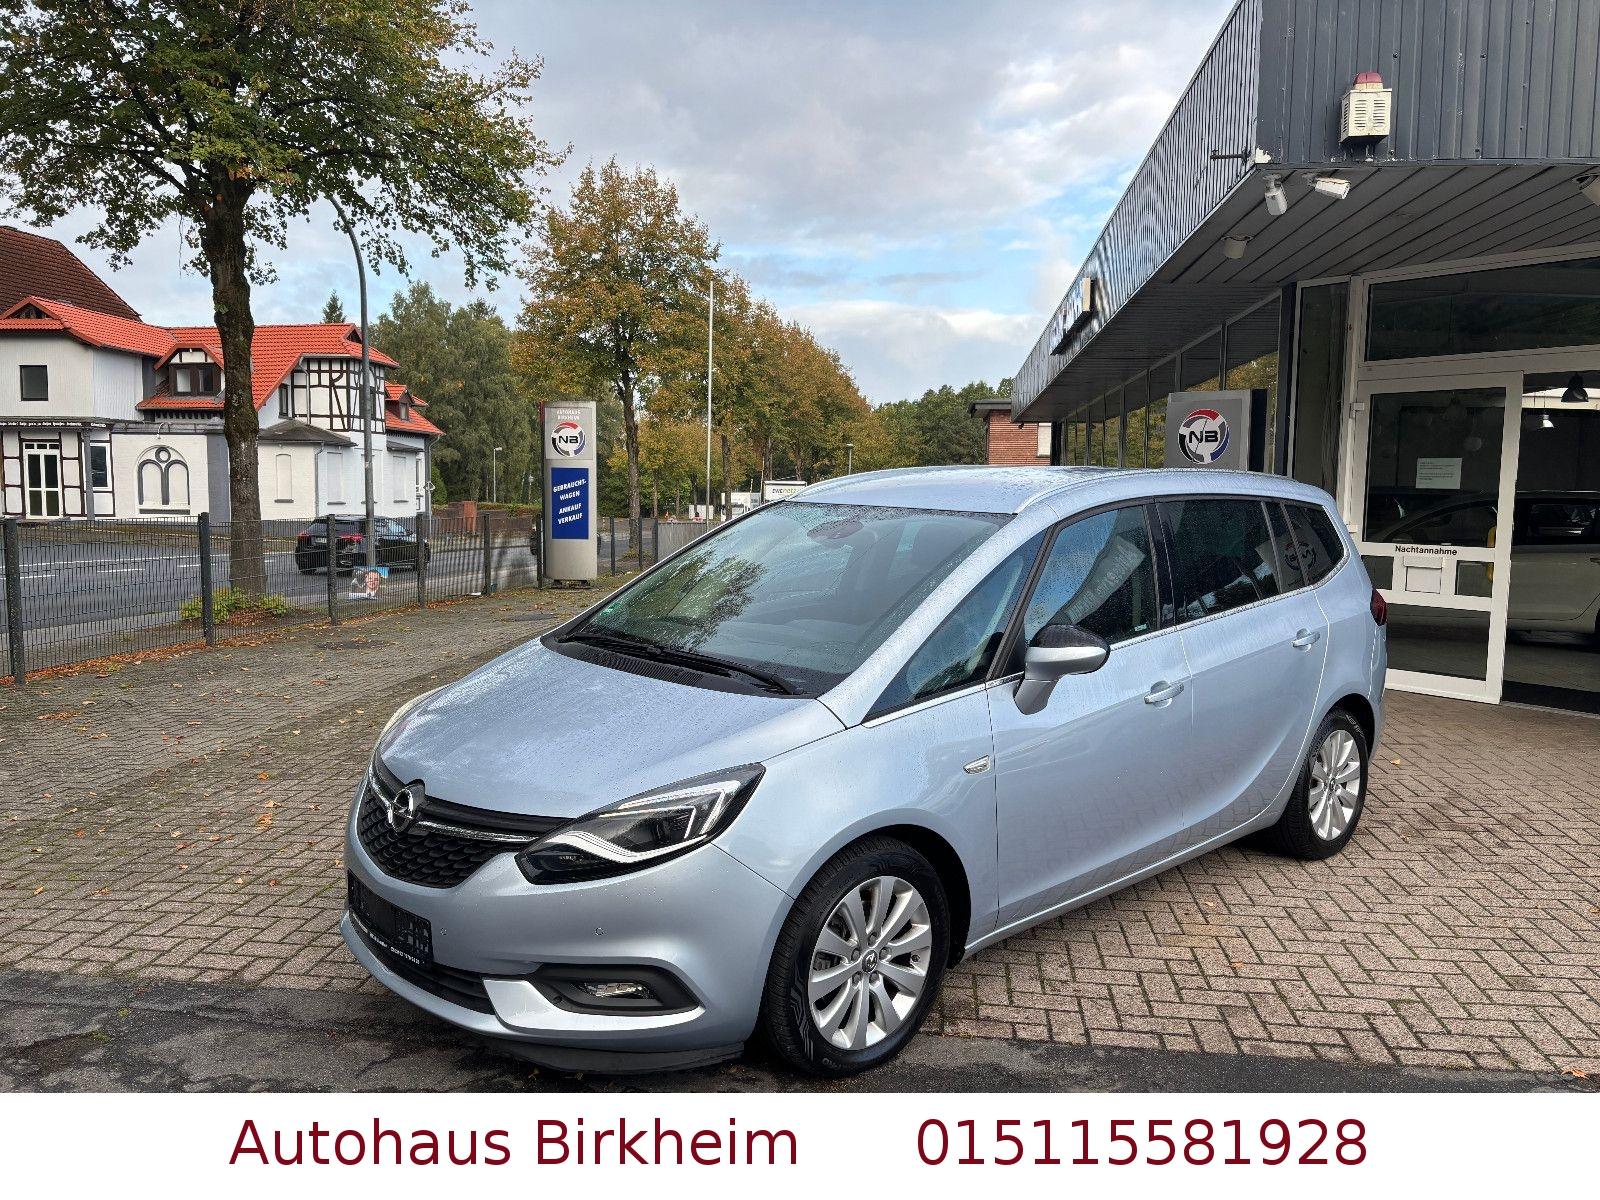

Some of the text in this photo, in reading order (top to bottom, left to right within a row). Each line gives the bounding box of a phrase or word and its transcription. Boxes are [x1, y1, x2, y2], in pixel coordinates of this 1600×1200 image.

[559, 435, 579, 444] NB
[1189, 430, 1219, 444] NB
[560, 490, 580, 501] WAGEN
[559, 503, 582, 515] ANKAUF
[557, 512, 583, 525] VERKAUF
[1395, 545, 1458, 556] Nachtannahme
